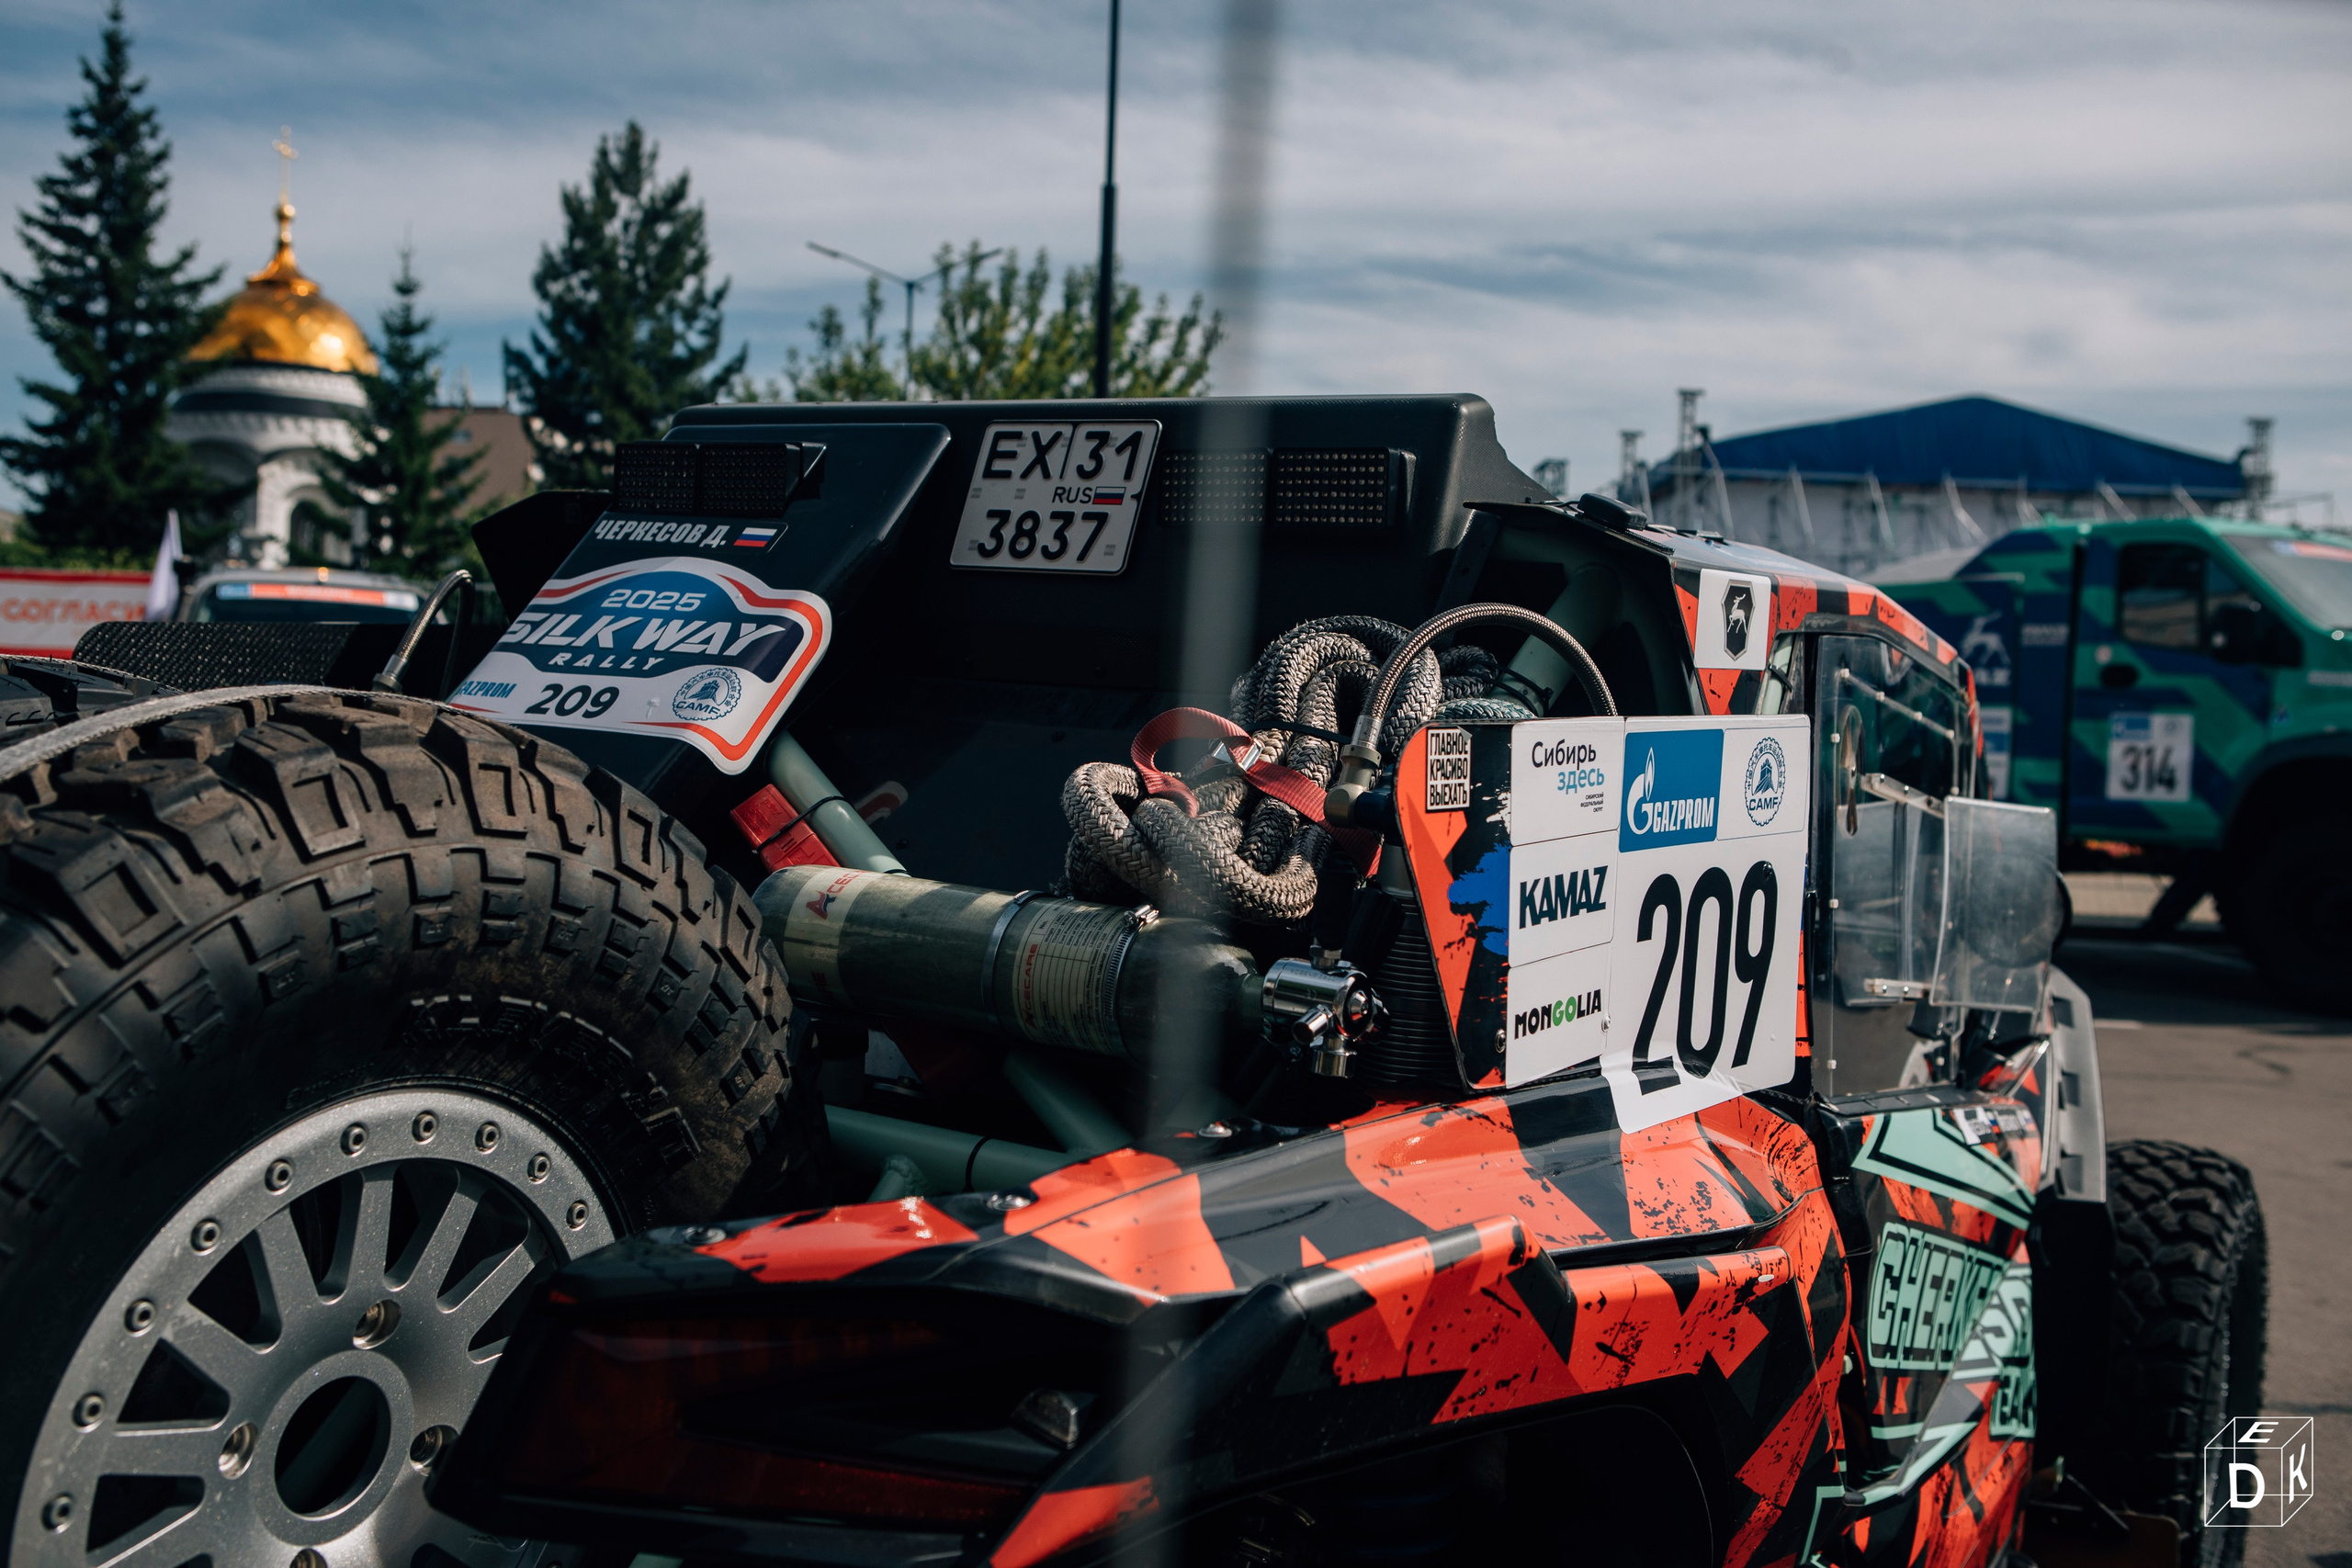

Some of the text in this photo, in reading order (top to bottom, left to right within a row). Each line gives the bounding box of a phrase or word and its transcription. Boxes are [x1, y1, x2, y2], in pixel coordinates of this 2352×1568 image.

[982, 431, 1144, 480] EX 31
[1052, 487, 1092, 503] RUS
[594, 520, 730, 548] ЧЕРКЕСОВ Д.
[978, 510, 1109, 562] 3837
[601, 589, 707, 612] 2025
[497, 612, 786, 656] SILK WAY
[548, 652, 665, 670] RALLY
[458, 681, 517, 698] AZPROM
[524, 683, 620, 719] 209
[676, 701, 720, 715] CAMF
[1430, 733, 1468, 756] ГЛАВНОЕ
[1532, 739, 1597, 771] Сибирь
[1430, 758, 1468, 781] КРАСИВО
[1557, 768, 1604, 795] здесь
[2121, 745, 2176, 792] 314
[1430, 783, 1467, 807] ВЫЕХАТЬ
[1749, 797, 1779, 811] CAMF
[1653, 796, 1715, 833] GAZPROM
[1519, 865, 1608, 930] KAMAZ
[1632, 861, 1778, 1096] 209
[1514, 989, 1601, 1040] MONGOLIA
